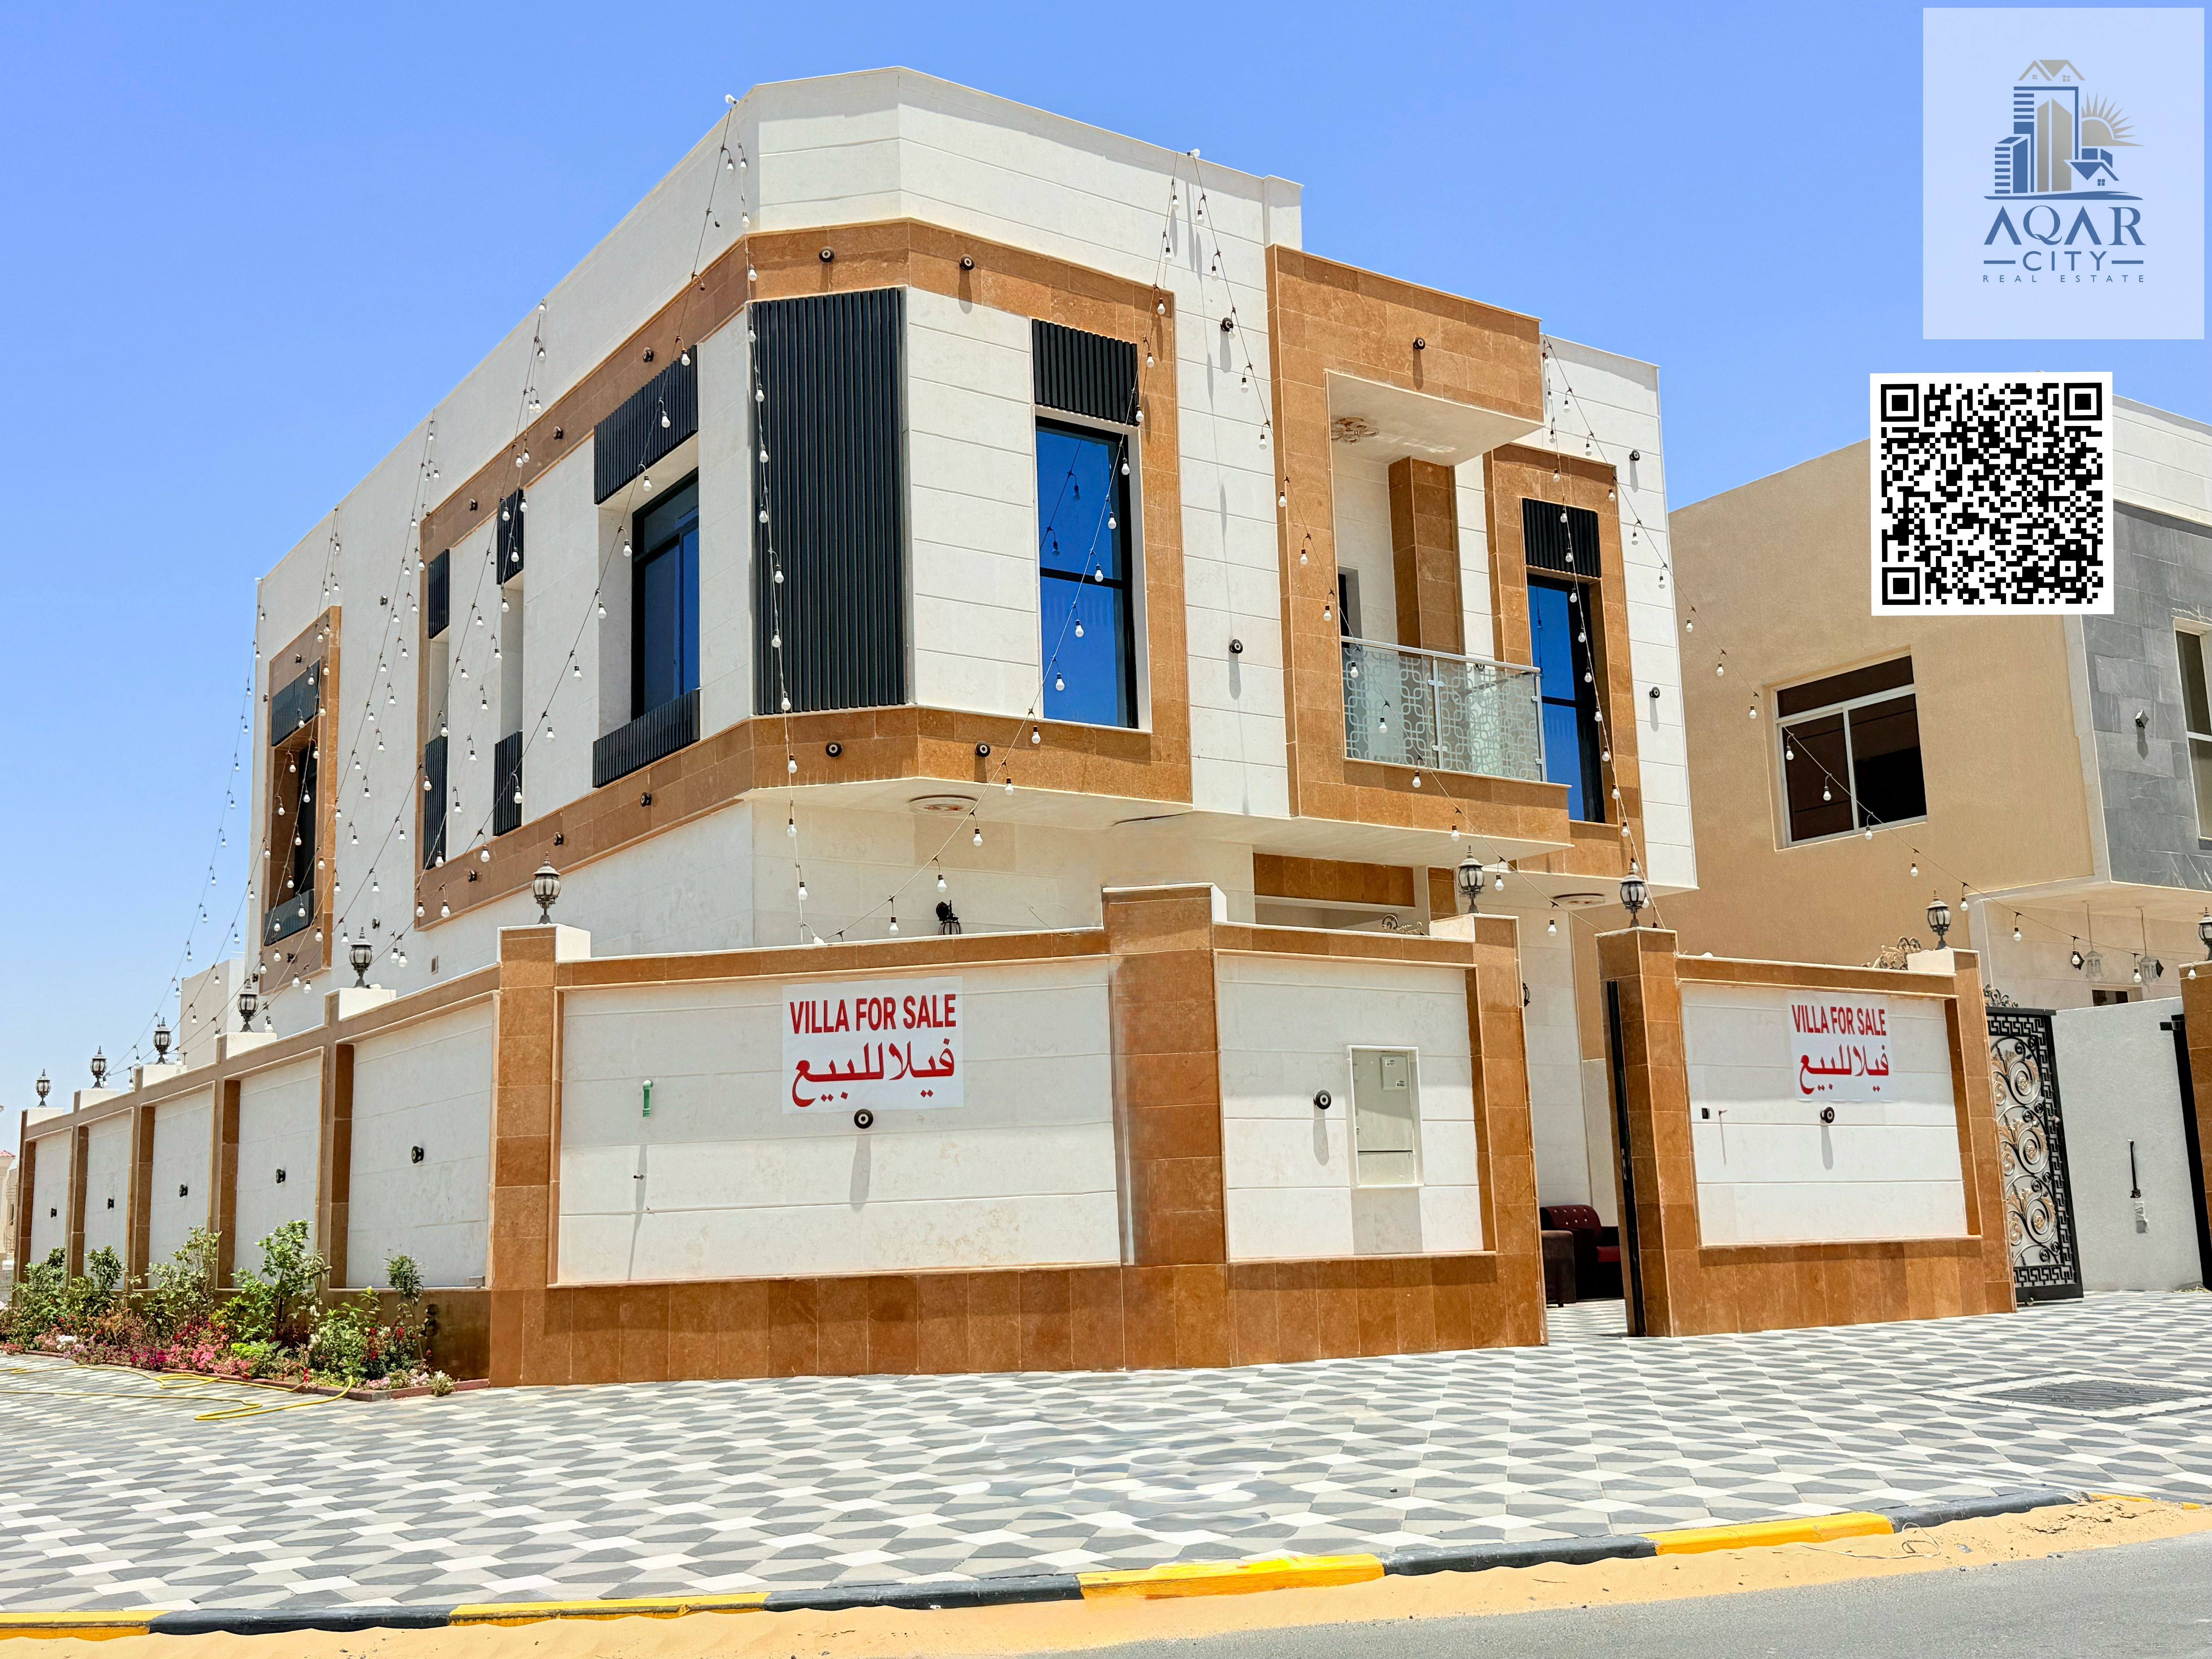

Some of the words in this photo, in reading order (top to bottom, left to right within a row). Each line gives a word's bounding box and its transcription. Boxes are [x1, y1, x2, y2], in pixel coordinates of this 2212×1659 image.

[790, 999, 850, 1034] VILLA
[856, 997, 896, 1031] FOR
[903, 993, 957, 1029] SALE
[1791, 1004, 1830, 1034] VILLA
[1830, 1006, 1855, 1035] FOR
[1856, 1007, 1887, 1036] SALE
